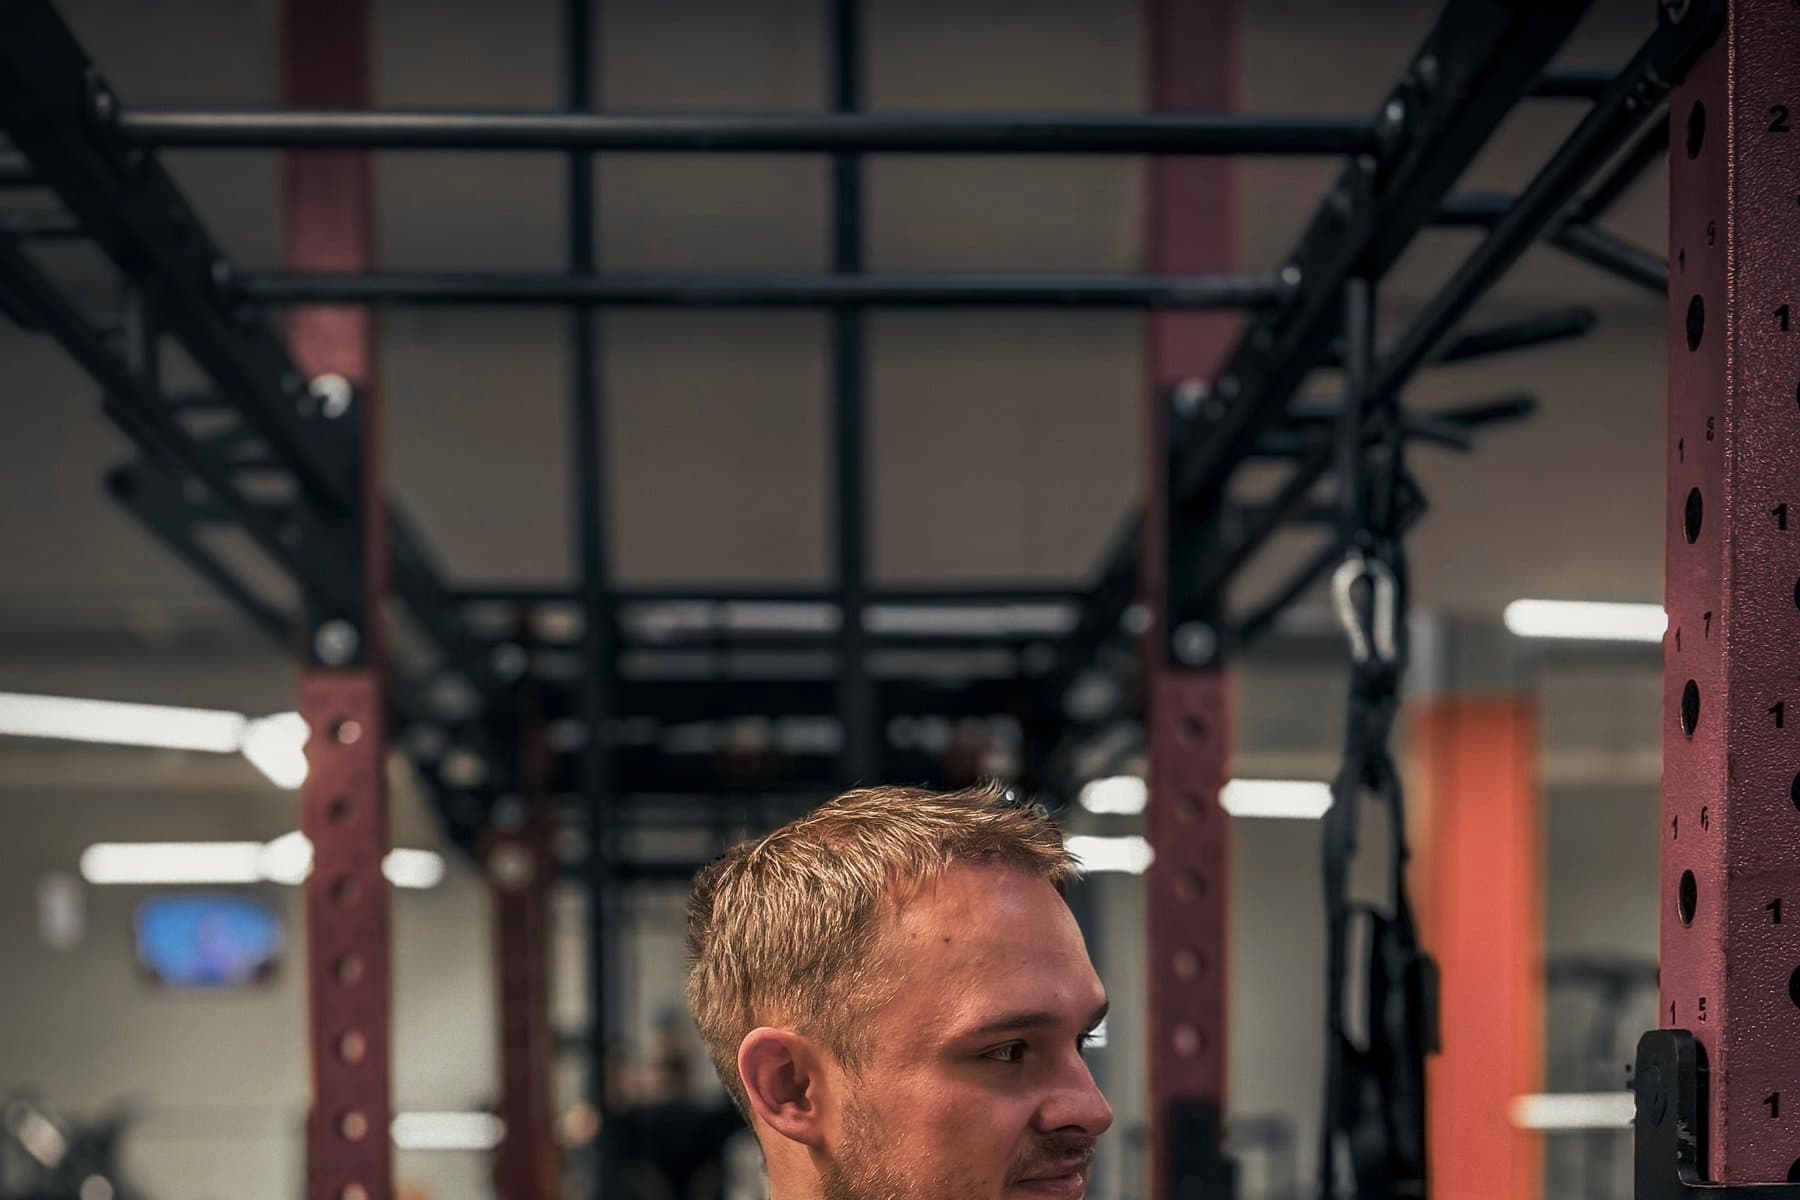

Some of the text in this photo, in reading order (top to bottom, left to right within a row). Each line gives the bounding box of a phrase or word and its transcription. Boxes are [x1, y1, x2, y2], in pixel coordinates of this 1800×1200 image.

[1767, 105, 1790, 133] 2
[1772, 304, 1790, 332] 1
[1771, 503, 1788, 531] 1
[1768, 701, 1785, 729] 1
[1765, 898, 1783, 925] 1
[1763, 1092, 1780, 1119] 1
